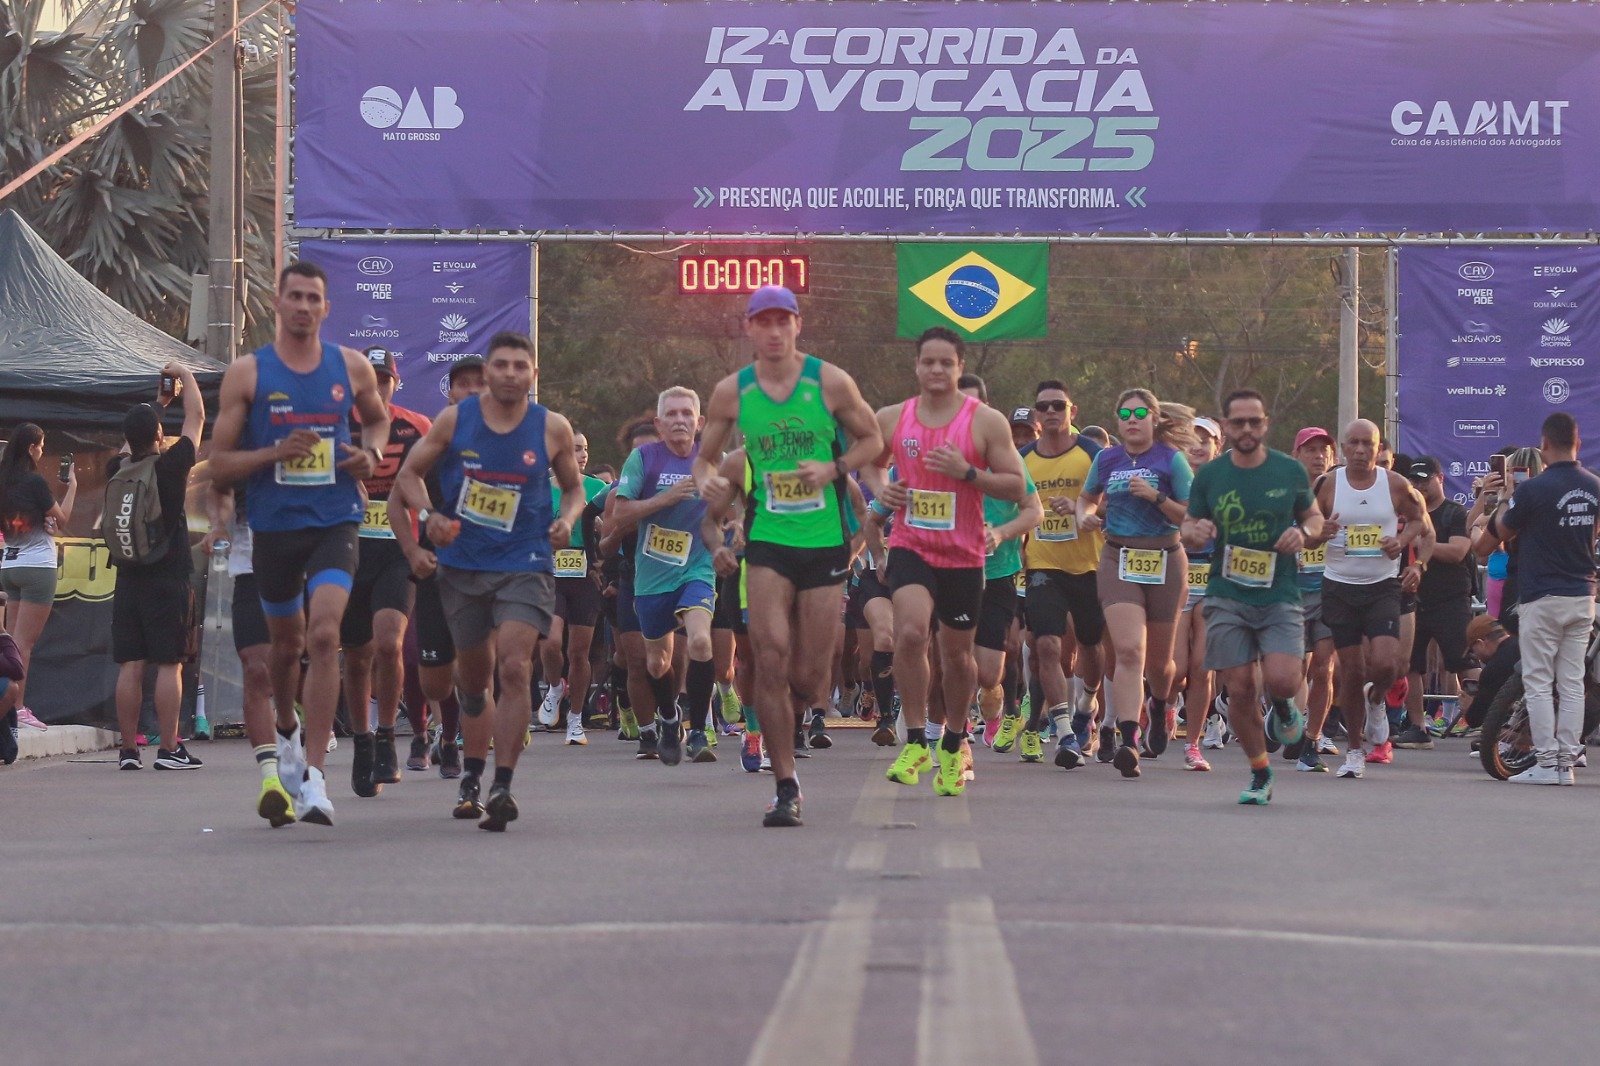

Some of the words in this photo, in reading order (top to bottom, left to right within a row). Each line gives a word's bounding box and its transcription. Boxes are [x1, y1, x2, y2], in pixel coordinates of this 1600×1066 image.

[789, 27, 1085, 64] CORRIDA
[1095, 48, 1138, 64] DA
[683, 69, 1154, 112] ADVOCACIA
[359, 86, 465, 129] OAB
[1391, 101, 1569, 135] CAAMT
[383, 133, 406, 142] MATO
[408, 133, 440, 142] GROSSO
[900, 116, 1160, 171] 2025
[1391, 138, 1417, 146] Caixa
[1420, 138, 1432, 146] de
[1434, 137, 1487, 146] Assistência
[1489, 138, 1506, 146] dos
[1509, 138, 1562, 148] Advogados
[719, 187, 802, 211] PRESENÇA
[807, 187, 838, 209] QUE
[842, 187, 909, 211] ACOLHE,
[914, 187, 966, 211] FORÇA
[970, 187, 1001, 209] QUE
[1005, 187, 1120, 209] TRANSFORMA.
[362, 260, 388, 270] CAV
[1463, 265, 1488, 275] CAV
[682, 259, 805, 290] 00:00:07
[356, 283, 392, 292] POWER
[1457, 289, 1493, 297] POWER
[373, 292, 392, 300] ADE
[1474, 297, 1494, 305] ADE
[439, 331, 469, 339] PANTANAL
[1541, 334, 1571, 342] PANTANAL
[1528, 356, 1585, 368] NESPRESSO
[1446, 386, 1493, 395] wellhub
[1551, 384, 1562, 396] D
[1458, 423, 1486, 431] Unimed
[471, 493, 507, 516] 1141
[914, 501, 945, 516] 1311
[115, 492, 134, 558] adidas
[1042, 518, 1070, 531] 1074
[652, 536, 684, 553] 1185
[1348, 534, 1378, 545] 1197
[556, 557, 582, 568] 1325
[1127, 559, 1160, 572] 1337
[1232, 557, 1267, 575] 1058
